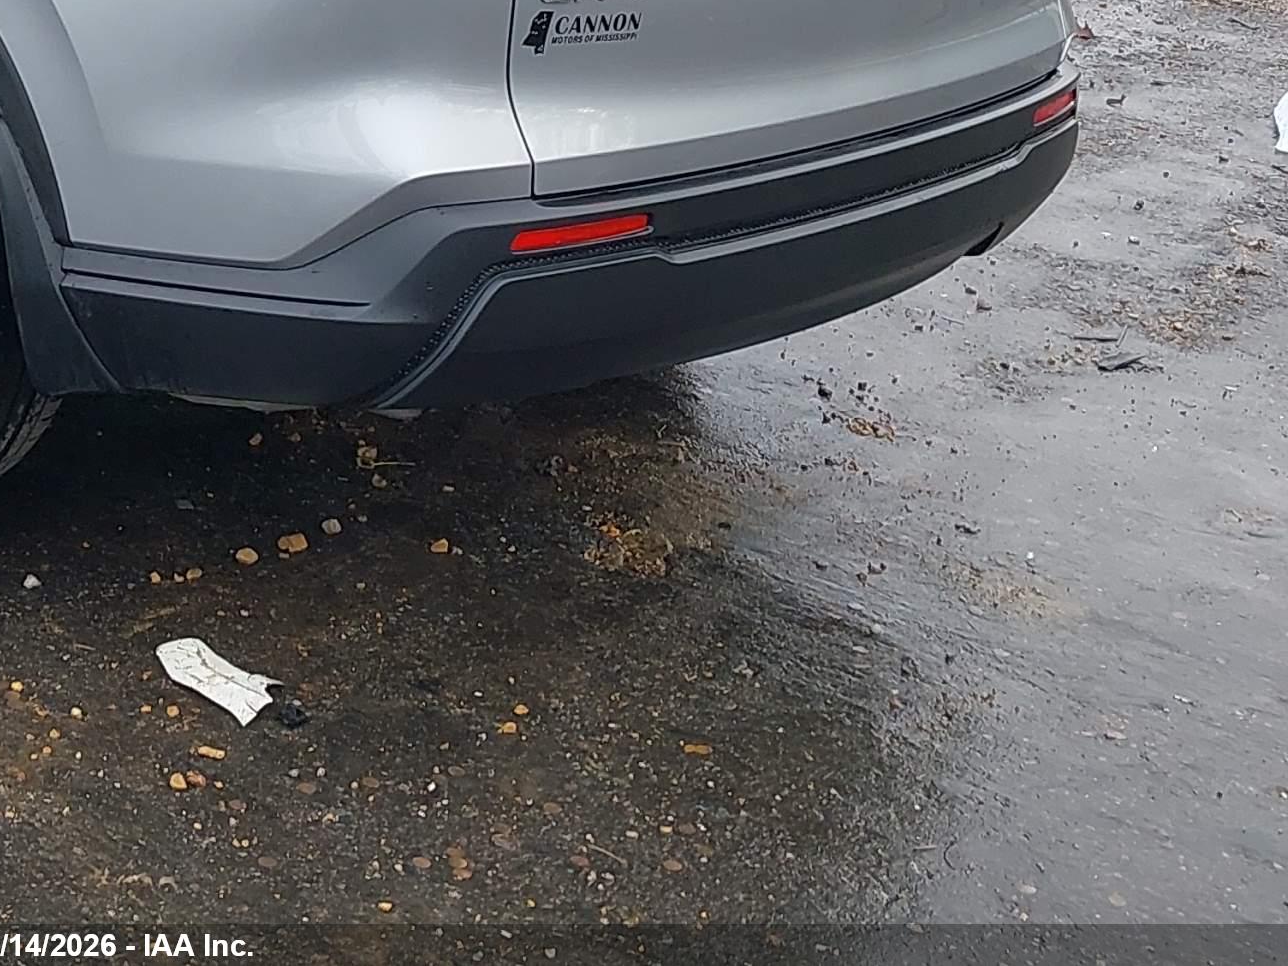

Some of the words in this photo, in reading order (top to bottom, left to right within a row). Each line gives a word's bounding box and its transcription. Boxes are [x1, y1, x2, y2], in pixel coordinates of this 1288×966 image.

[555, 12, 641, 34] CANNON
[551, 35, 583, 44] MOTORS
[584, 34, 595, 42] OF
[595, 32, 637, 42] MISSISSIPPI
